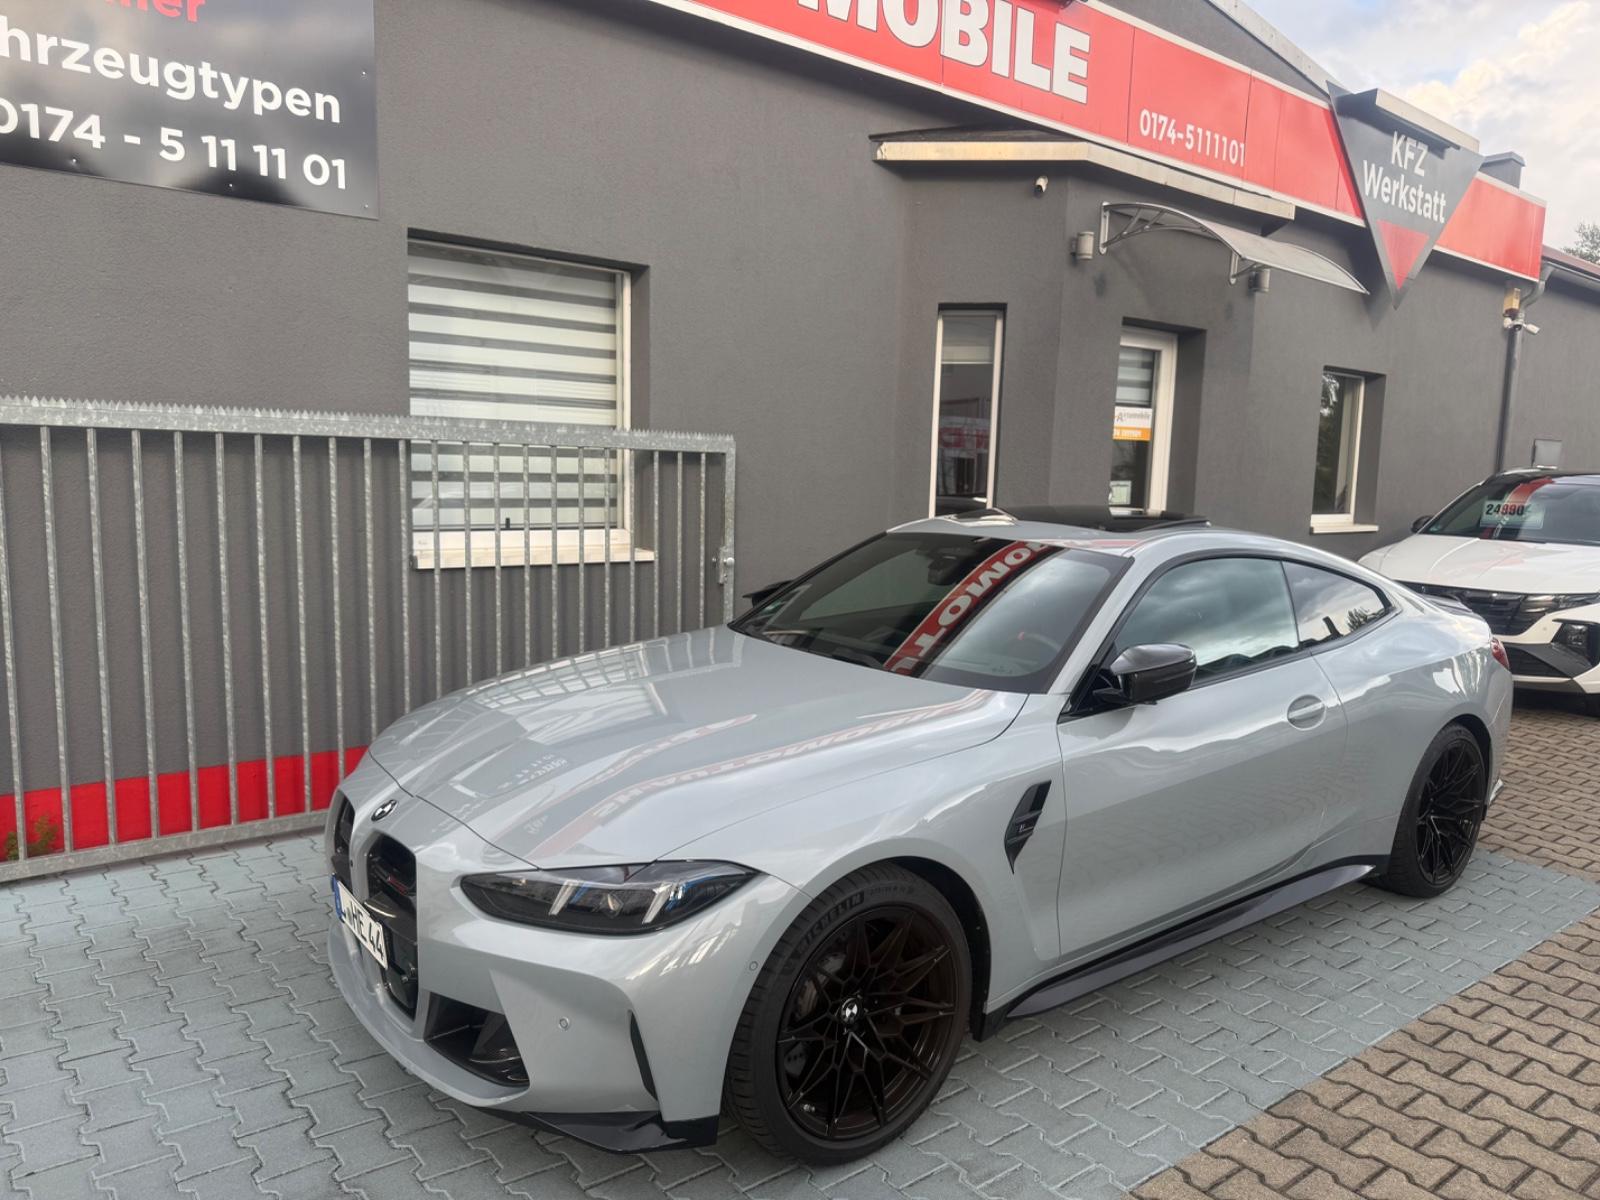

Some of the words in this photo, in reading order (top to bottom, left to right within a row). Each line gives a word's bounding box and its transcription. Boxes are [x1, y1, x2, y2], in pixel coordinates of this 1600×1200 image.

[0, 98, 106, 149] 0174
[159, 127, 186, 162] 5
[200, 135, 236, 171] 11
[252, 144, 287, 180] 11
[302, 154, 346, 190] 01
[1139, 108, 1245, 167] 0174-5111101
[1390, 131, 1429, 178] KFZ
[1363, 159, 1447, 224] Werkstatt
